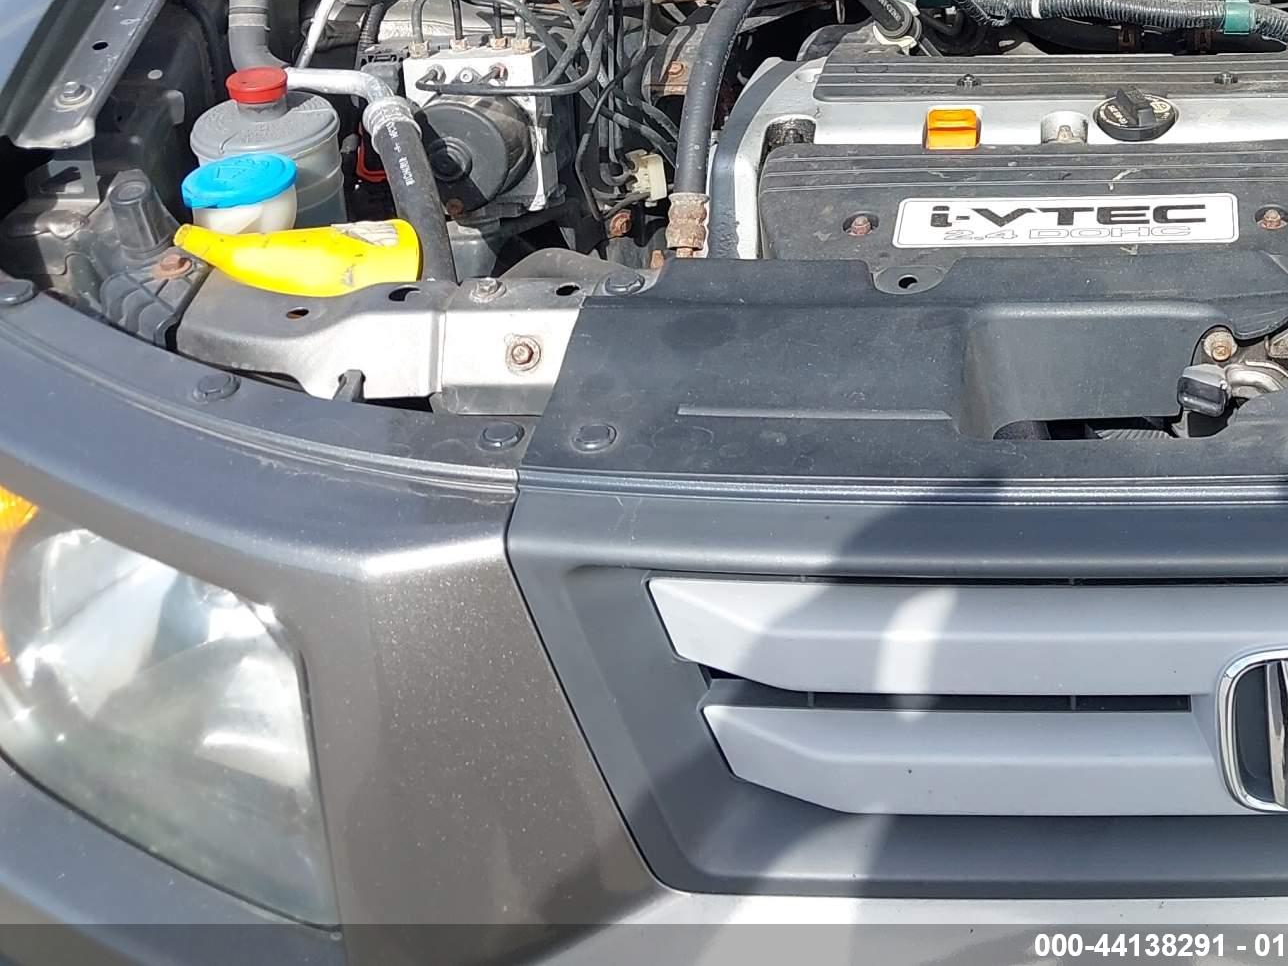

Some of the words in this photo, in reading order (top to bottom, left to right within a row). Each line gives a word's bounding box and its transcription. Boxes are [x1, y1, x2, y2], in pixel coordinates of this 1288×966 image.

[930, 204, 1206, 228] i-VTEC
[943, 229, 1018, 241] 2.4
[1028, 226, 1192, 240] DOHC
